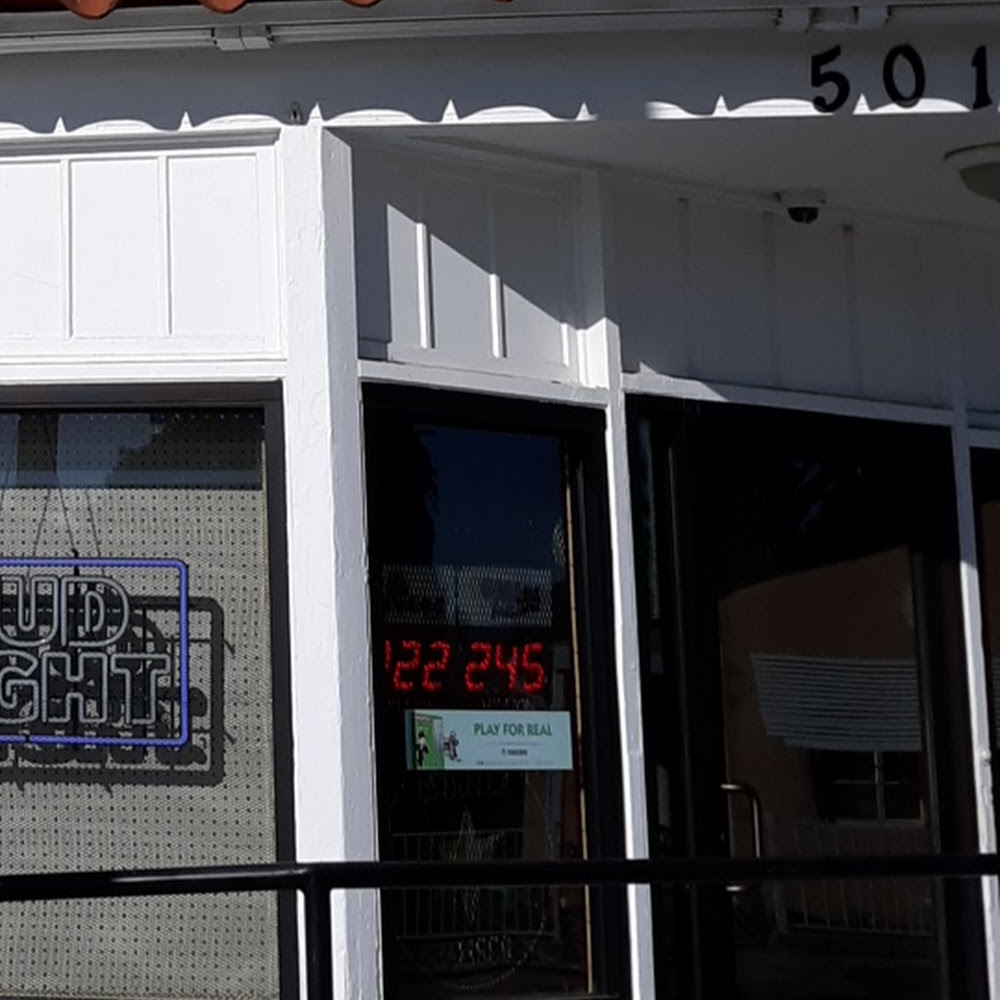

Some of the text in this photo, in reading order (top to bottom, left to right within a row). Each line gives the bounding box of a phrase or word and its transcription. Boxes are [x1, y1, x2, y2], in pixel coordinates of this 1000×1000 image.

[811, 43, 993, 114] 501
[464, 642, 546, 693] 245
[474, 722, 553, 736] PLAY FOR REAL
